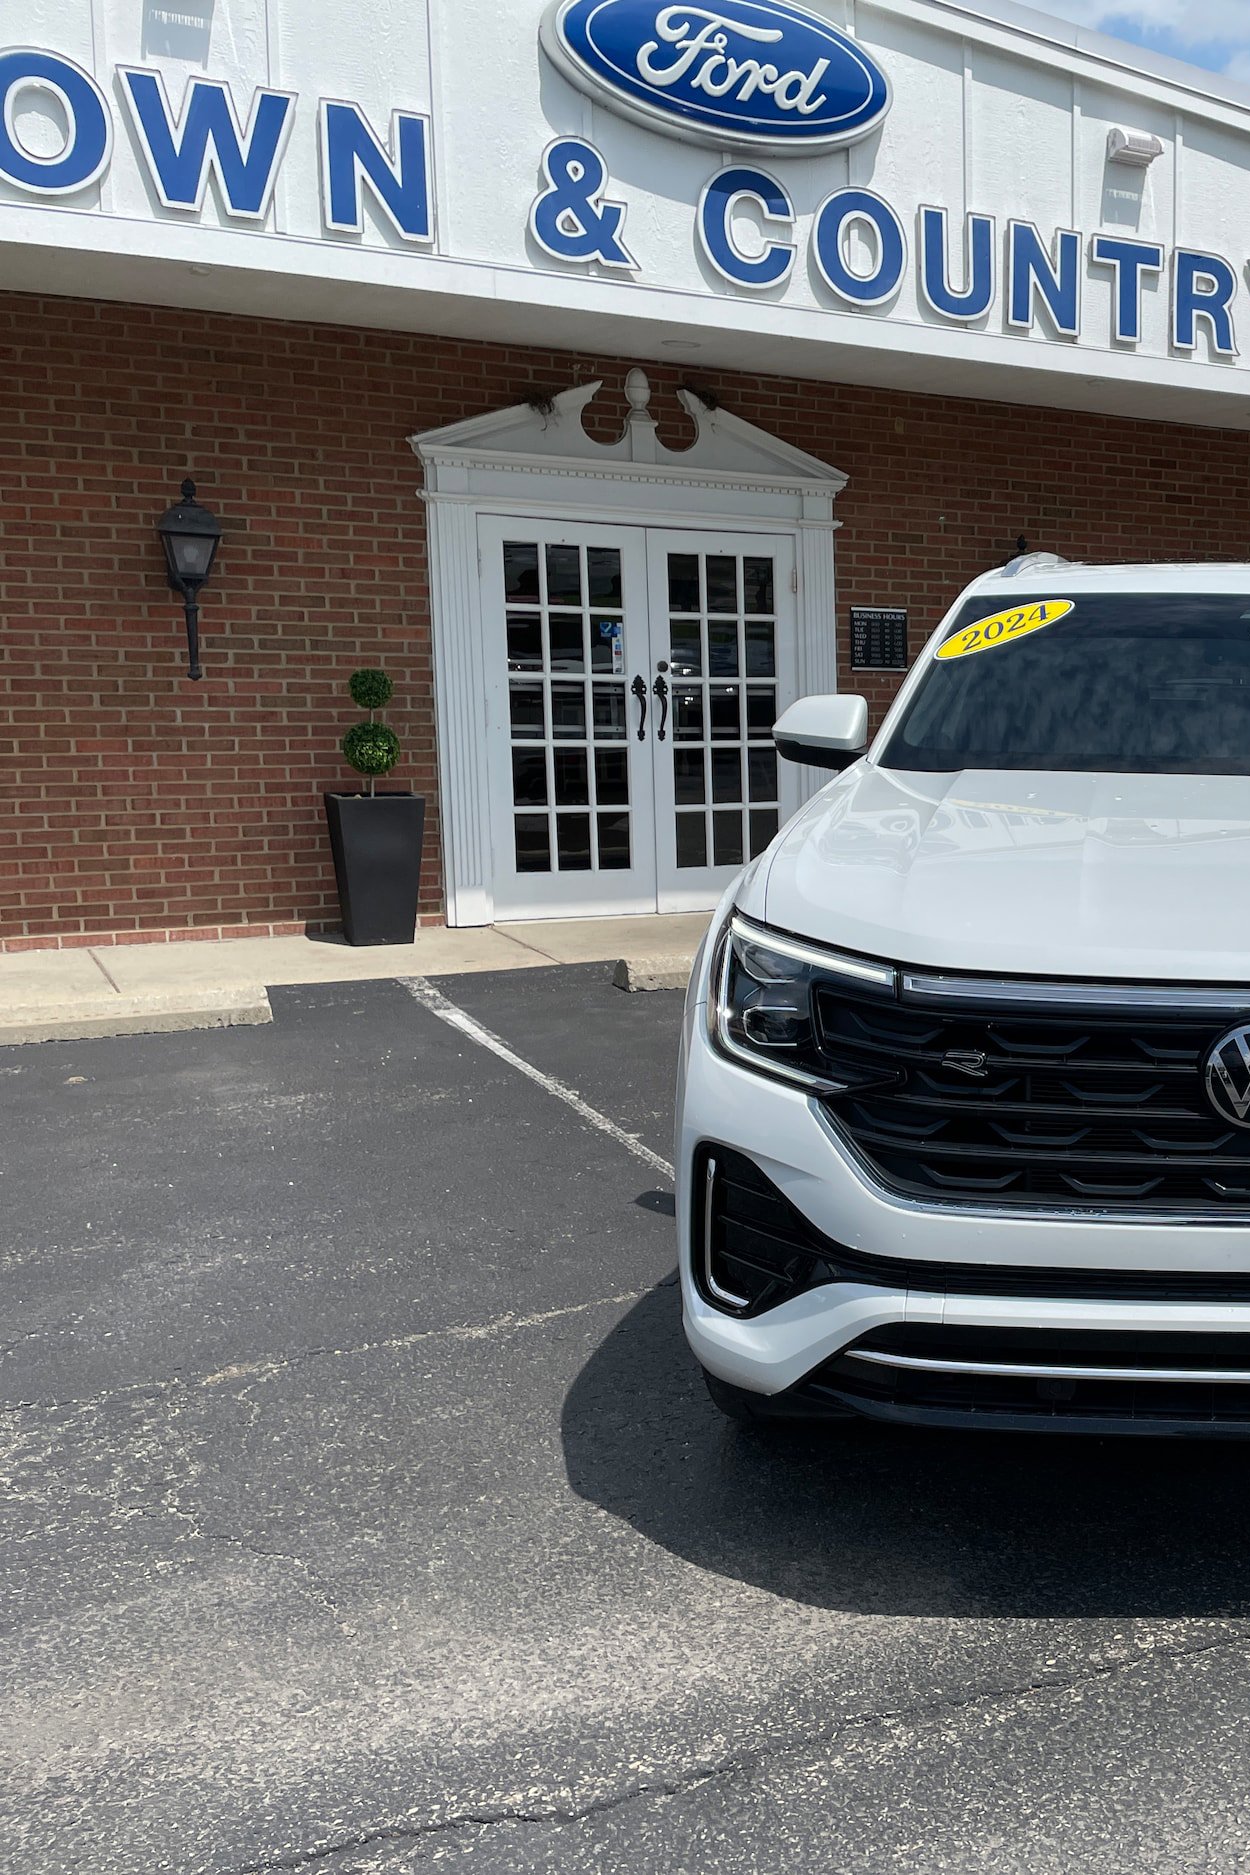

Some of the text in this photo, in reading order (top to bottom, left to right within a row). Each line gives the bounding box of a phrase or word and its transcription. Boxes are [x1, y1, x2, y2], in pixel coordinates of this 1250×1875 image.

[636, 5, 831, 115] Ford
[530, 135, 642, 271] &
[853, 612, 906, 621] BUSINESS HOURS
[962, 604, 1052, 652] 2024
